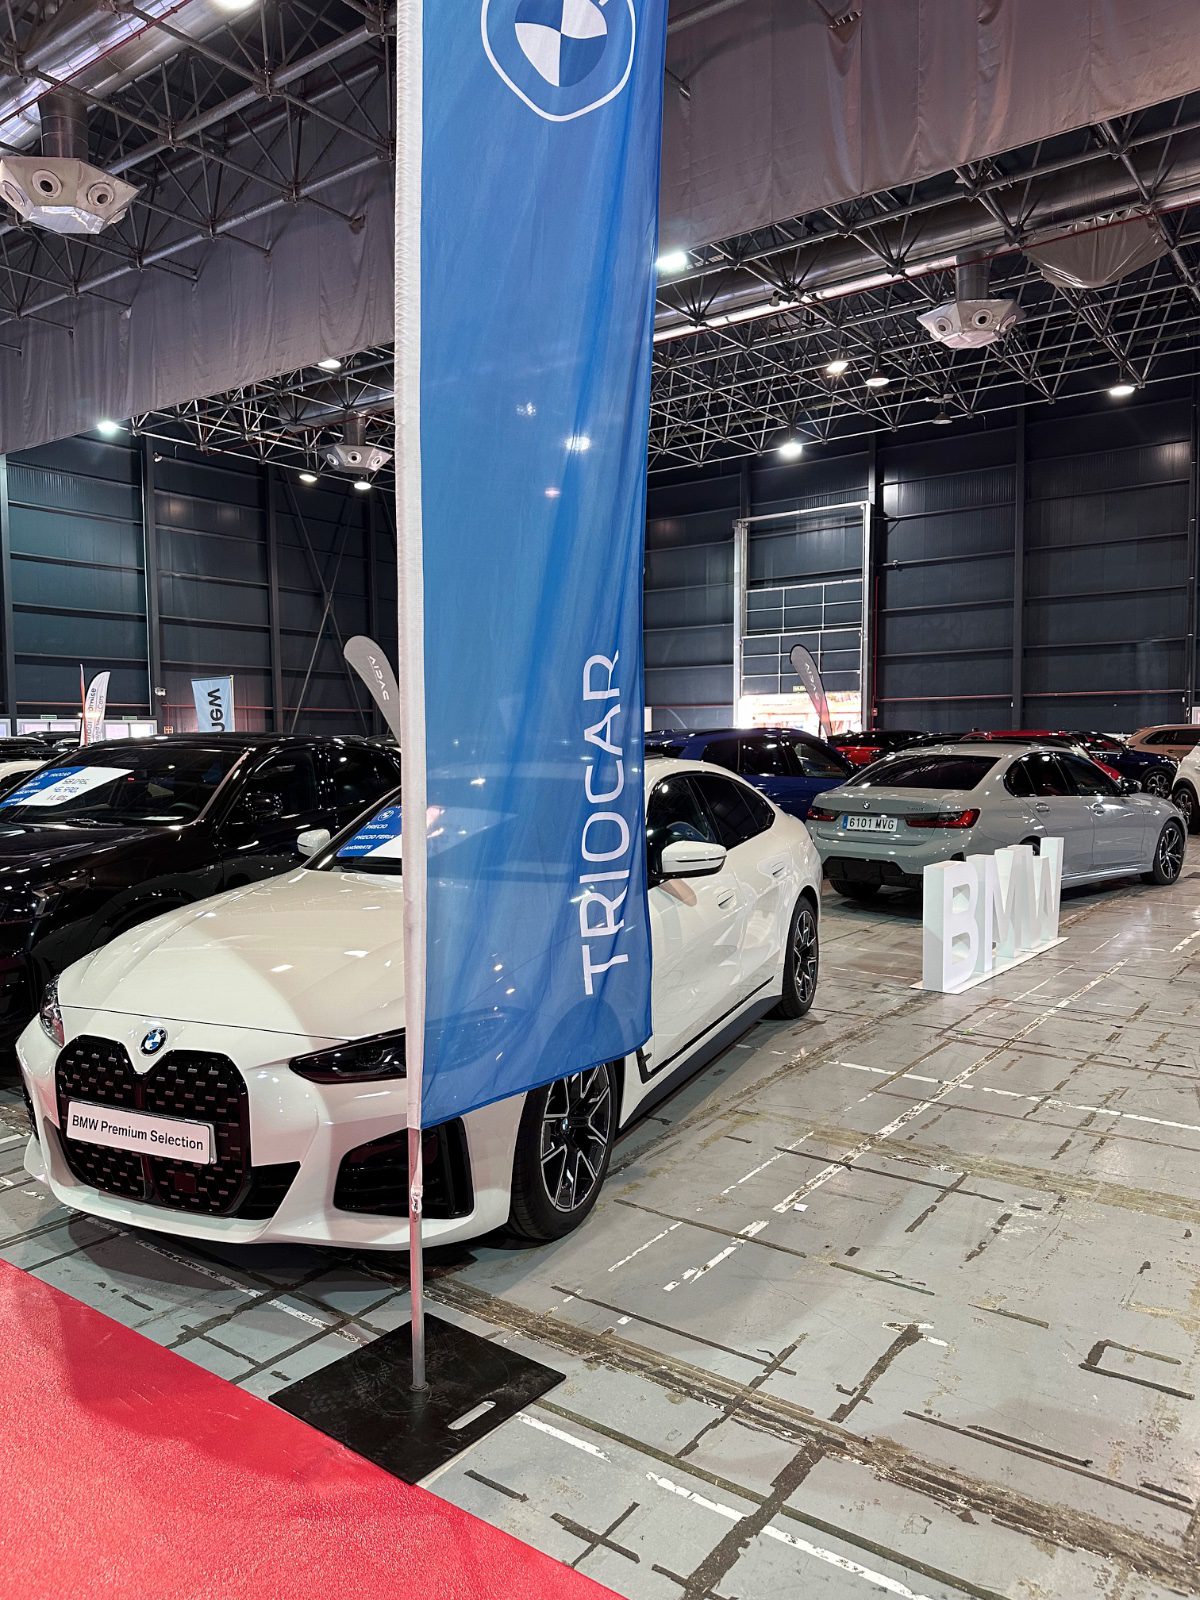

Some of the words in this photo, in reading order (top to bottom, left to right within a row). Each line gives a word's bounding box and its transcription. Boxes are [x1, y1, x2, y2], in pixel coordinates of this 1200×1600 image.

[579, 649, 630, 995] TRIOCAR
[849, 817, 873, 829] 6101
[875, 818, 895, 830] MVG
[923, 837, 1065, 992] BMW
[72, 1114, 99, 1132] BMW
[100, 1120, 147, 1141] Premium
[150, 1130, 204, 1151] Selection
